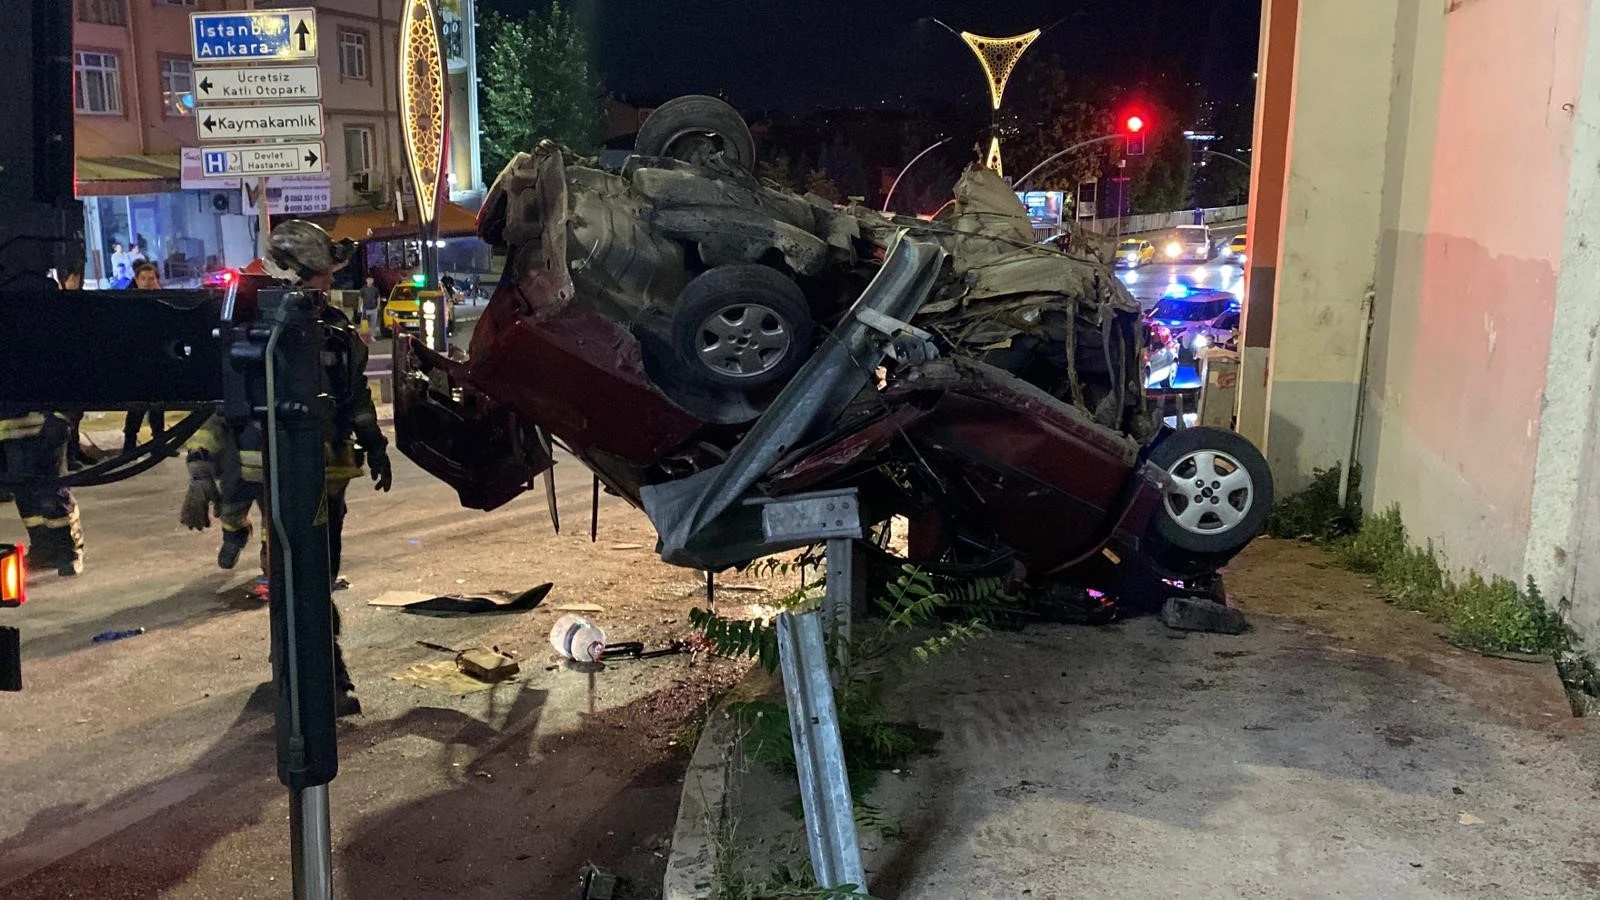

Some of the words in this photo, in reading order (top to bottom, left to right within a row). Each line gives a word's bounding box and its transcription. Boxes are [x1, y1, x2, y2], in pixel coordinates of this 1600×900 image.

[201, 41, 269, 56] Ankara
[238, 71, 290, 83] Ücretsiz
[223, 85, 251, 96] Katlı
[256, 83, 306, 97] Otopark
[218, 114, 316, 132] Kaymakamlık
[208, 153, 223, 172] H
[254, 151, 283, 160] Devlet
[248, 161, 293, 170] Hastanesi
